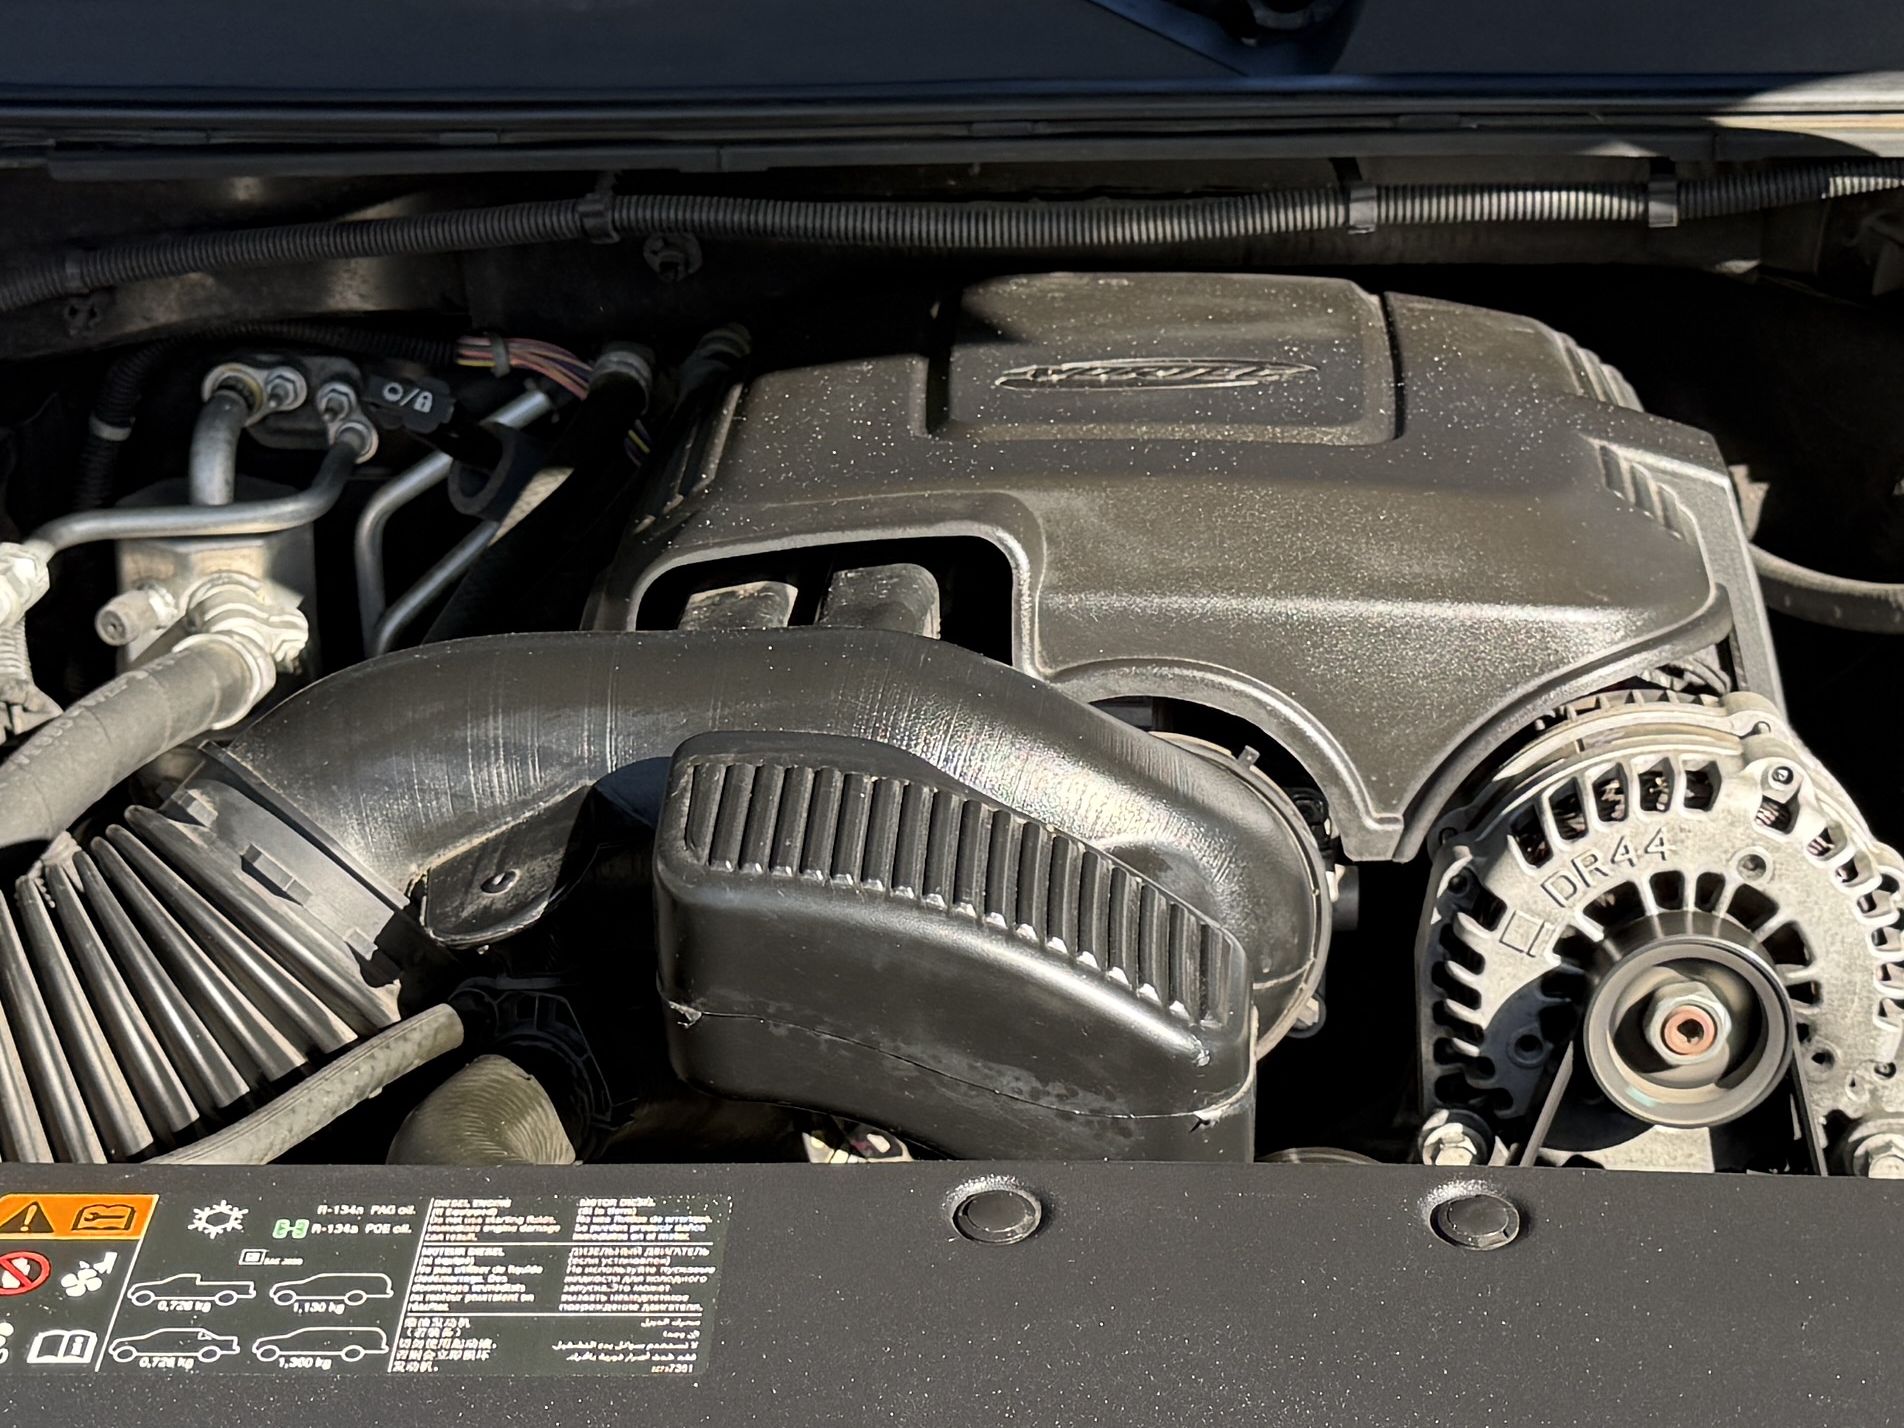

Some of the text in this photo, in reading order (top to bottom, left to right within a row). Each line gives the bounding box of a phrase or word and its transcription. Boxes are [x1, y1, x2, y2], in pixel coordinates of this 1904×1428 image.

[1540, 827, 1676, 908] DR44
[433, 1198, 513, 1209] DIESEL ENGINE
[579, 1198, 618, 1207] MOTOR
[316, 1204, 416, 1216] R-134a PAG oil.
[484, 1216, 525, 1226] starting
[310, 1223, 413, 1234] R-134a POE oil.
[482, 1224, 519, 1235] engine
[519, 1224, 562, 1235] damage
[424, 1233, 445, 1241] can
[421, 1246, 506, 1257] MOTEUR DIESEL
[194, 1300, 212, 1315] kg
[327, 1301, 346, 1315] kg
[177, 1356, 195, 1370] kg
[313, 1356, 333, 1371] kg
